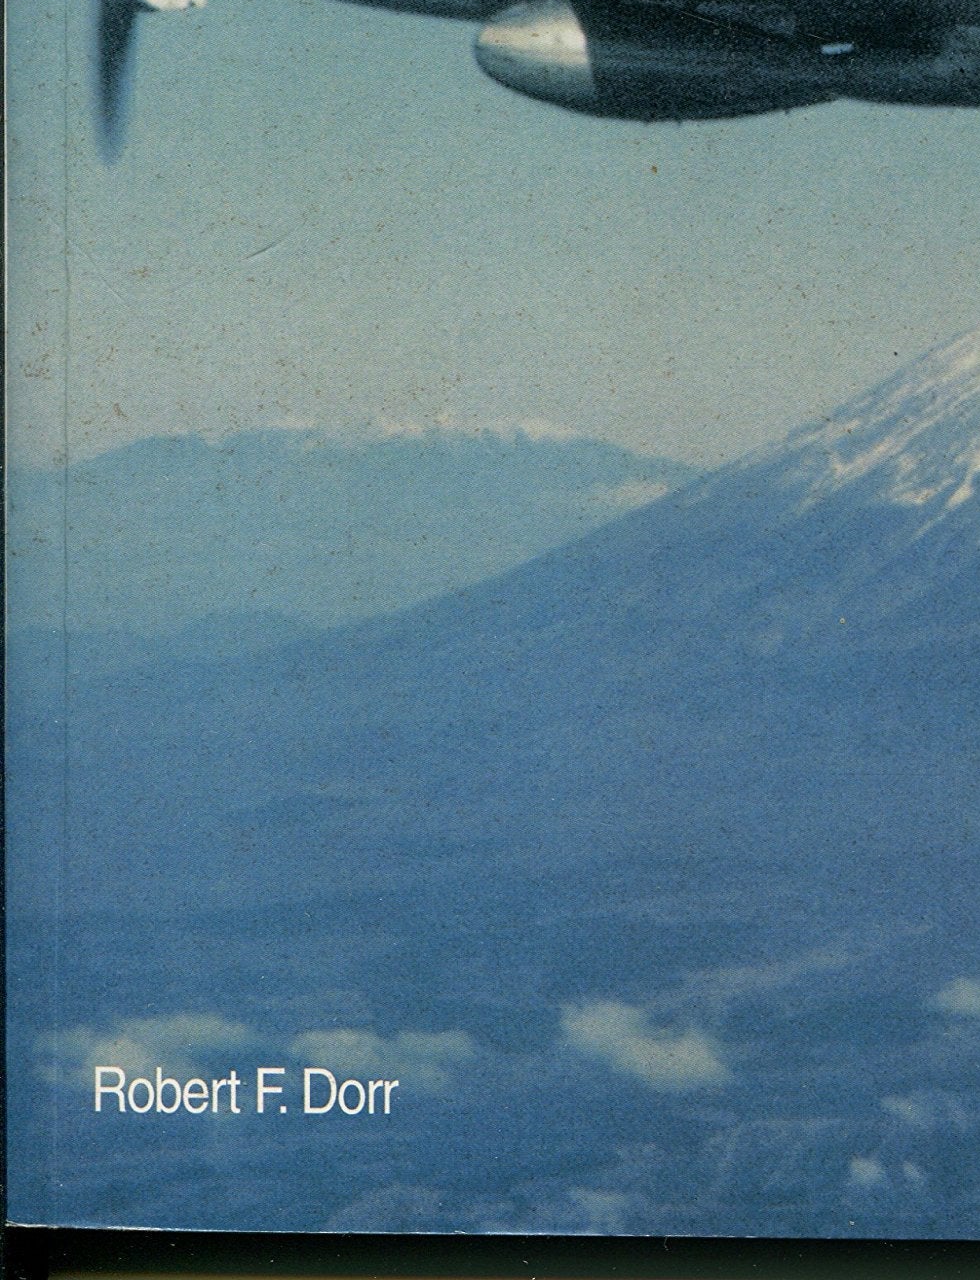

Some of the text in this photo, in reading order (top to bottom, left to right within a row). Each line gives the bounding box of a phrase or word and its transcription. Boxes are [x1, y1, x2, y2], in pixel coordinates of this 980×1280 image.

[94, 1066, 400, 1115] Robert F. Dorr
